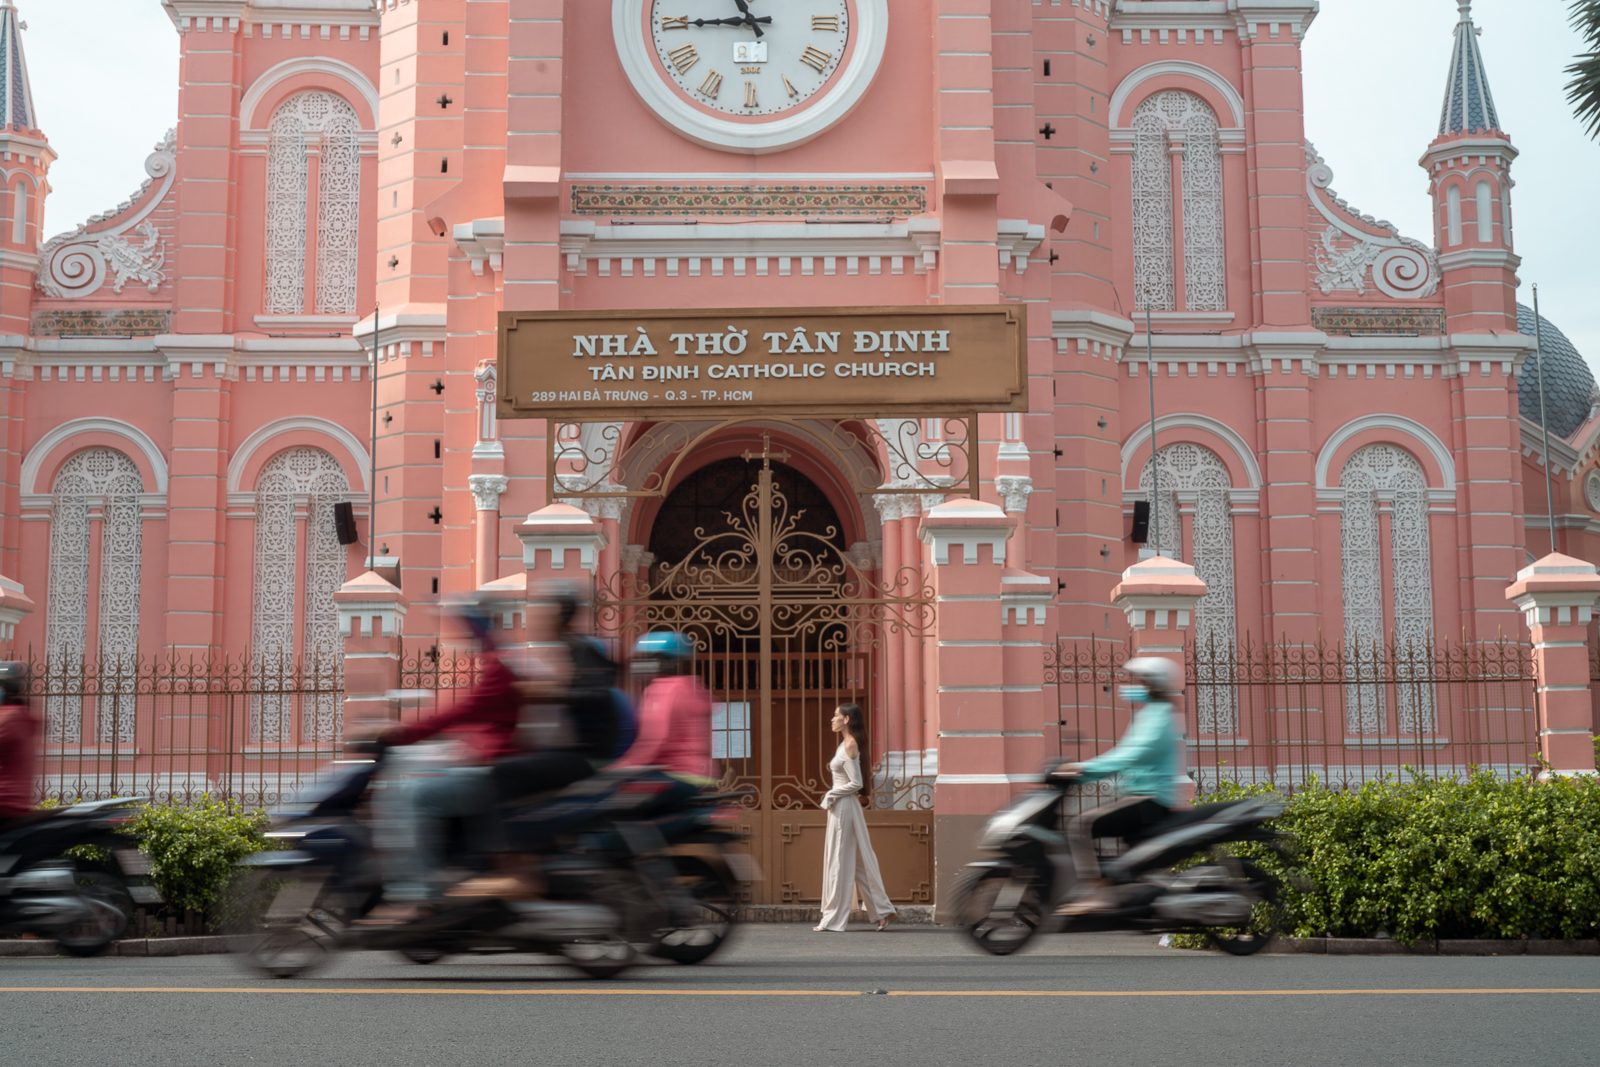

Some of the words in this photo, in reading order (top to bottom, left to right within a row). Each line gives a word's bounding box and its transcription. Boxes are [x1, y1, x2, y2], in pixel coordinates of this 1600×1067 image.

[572, 326, 658, 357] NHÀ
[669, 325, 749, 355] THỜ
[762, 326, 841, 354] TÂN
[853, 330, 951, 358] ĐỊNH
[588, 363, 635, 381] TÂN
[641, 364, 699, 383] ĐỊNH
[707, 363, 826, 379] CATHOLIC
[833, 361, 935, 377] CHURCH
[531, 391, 557, 402] 289
[559, 391, 581, 402] HAI
[583, 388, 601, 402] BÀ
[604, 389, 649, 402] TRƯNG
[664, 390, 688, 402] Q.3
[700, 390, 721, 401] TP.
[723, 390, 753, 401] HCM
